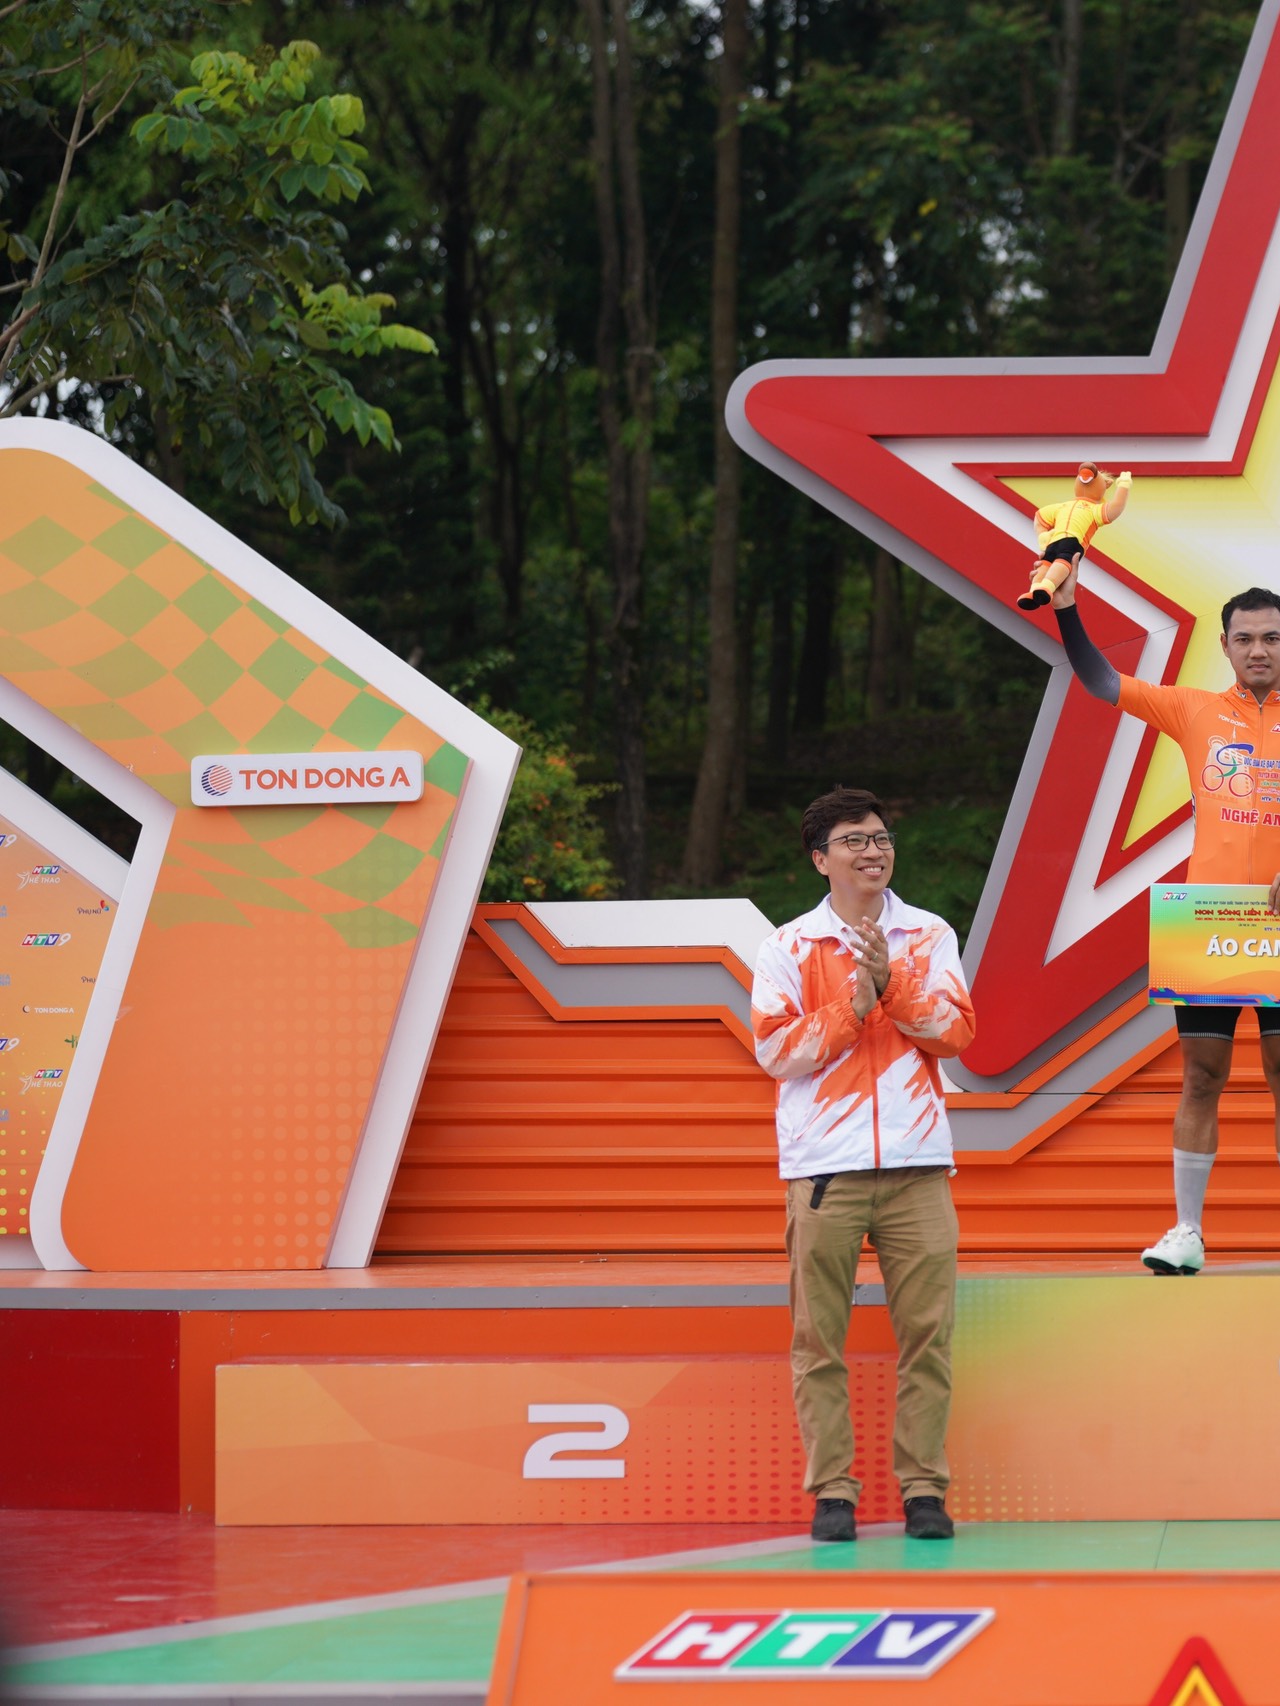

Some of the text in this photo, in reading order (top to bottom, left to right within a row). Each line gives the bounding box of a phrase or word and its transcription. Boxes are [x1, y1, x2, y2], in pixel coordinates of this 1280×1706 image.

[239, 766, 411, 790] TON DONG A
[1221, 807, 1258, 826] NGHỆ
[33, 866, 59, 874] HTV
[1163, 892, 1187, 900] HTV
[1217, 908, 1240, 916] SÔNG
[1206, 934, 1239, 956] ÁO
[35, 1070, 62, 1078] HTV
[522, 1404, 630, 1480] 2
[649, 1619, 962, 1662] HTV
